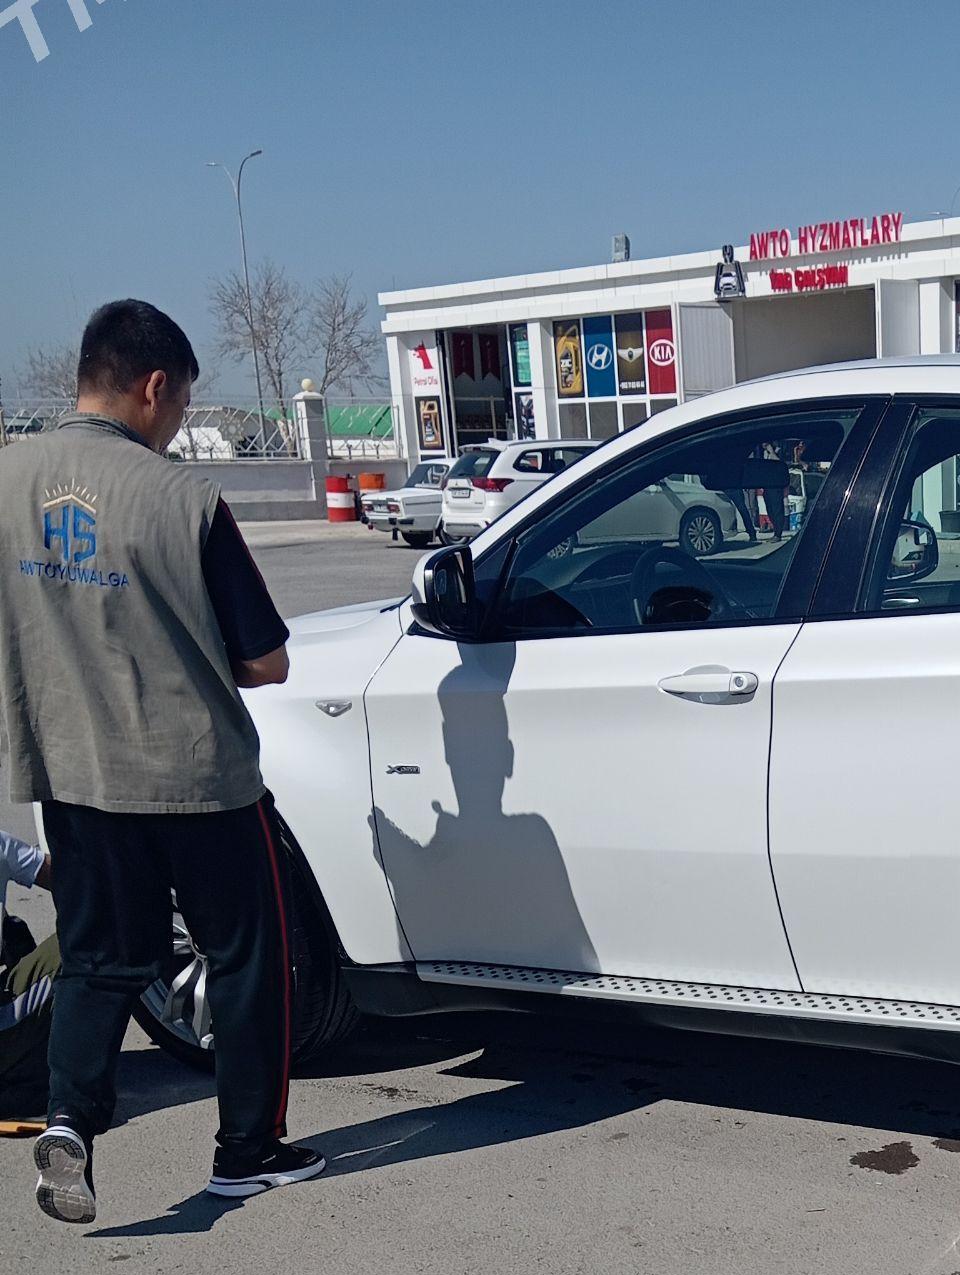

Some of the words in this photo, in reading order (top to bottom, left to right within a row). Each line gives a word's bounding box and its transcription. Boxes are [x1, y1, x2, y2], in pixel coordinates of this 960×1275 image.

[749, 229, 790, 260] AWTO
[798, 212, 903, 254] HYZMATLARY
[653, 345, 672, 361] KIA
[44, 504, 96, 563] HS
